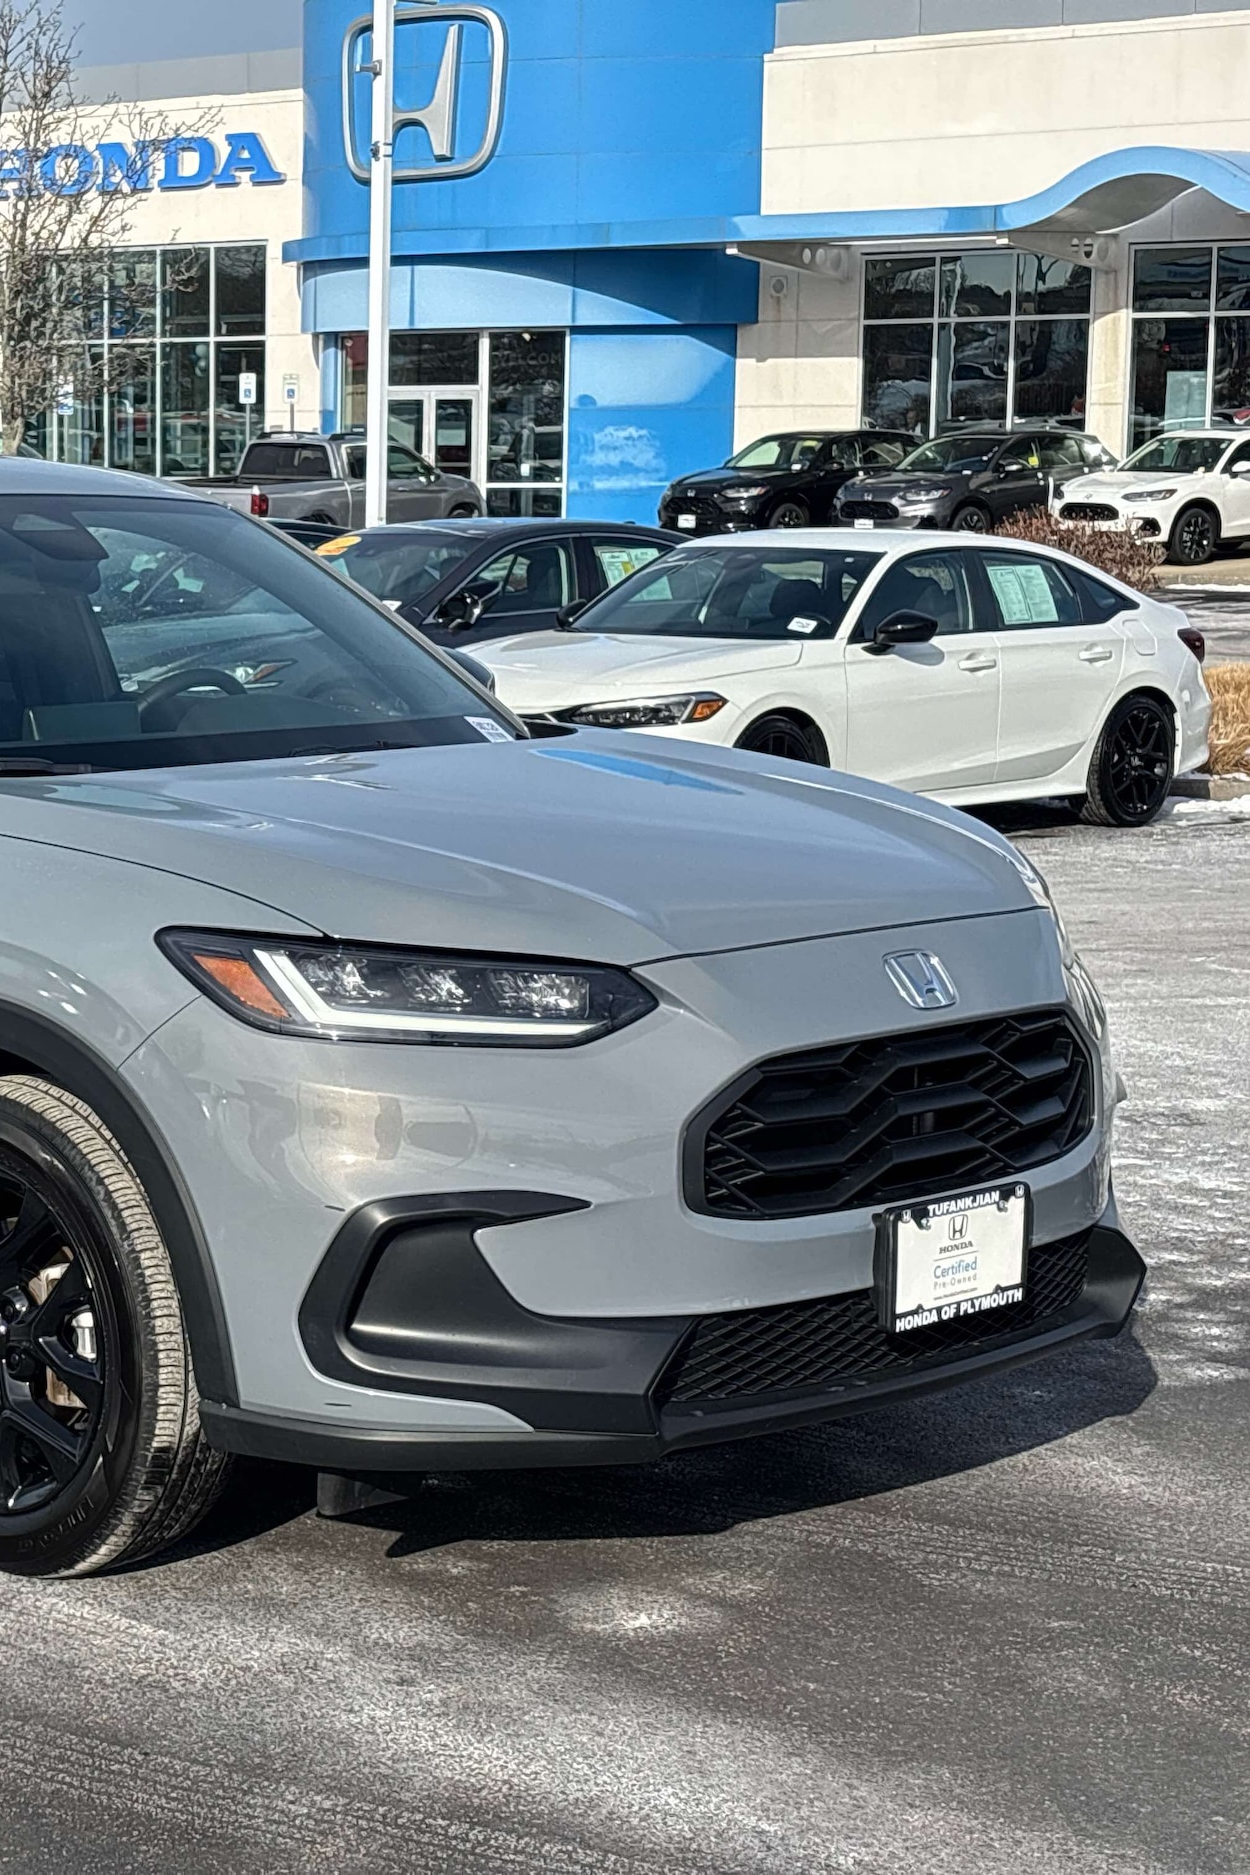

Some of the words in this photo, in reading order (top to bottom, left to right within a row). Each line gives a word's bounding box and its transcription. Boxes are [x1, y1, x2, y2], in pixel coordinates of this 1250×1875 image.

[927, 1190, 1000, 1217] TUFANKJIAN
[938, 1240, 974, 1254] HONDA
[933, 1256, 978, 1279] Certified
[933, 1273, 978, 1291] Pre-Owned
[895, 1308, 938, 1333] HONDA
[941, 1303, 958, 1320] OF
[960, 1288, 1023, 1317] PLYMOUTH
